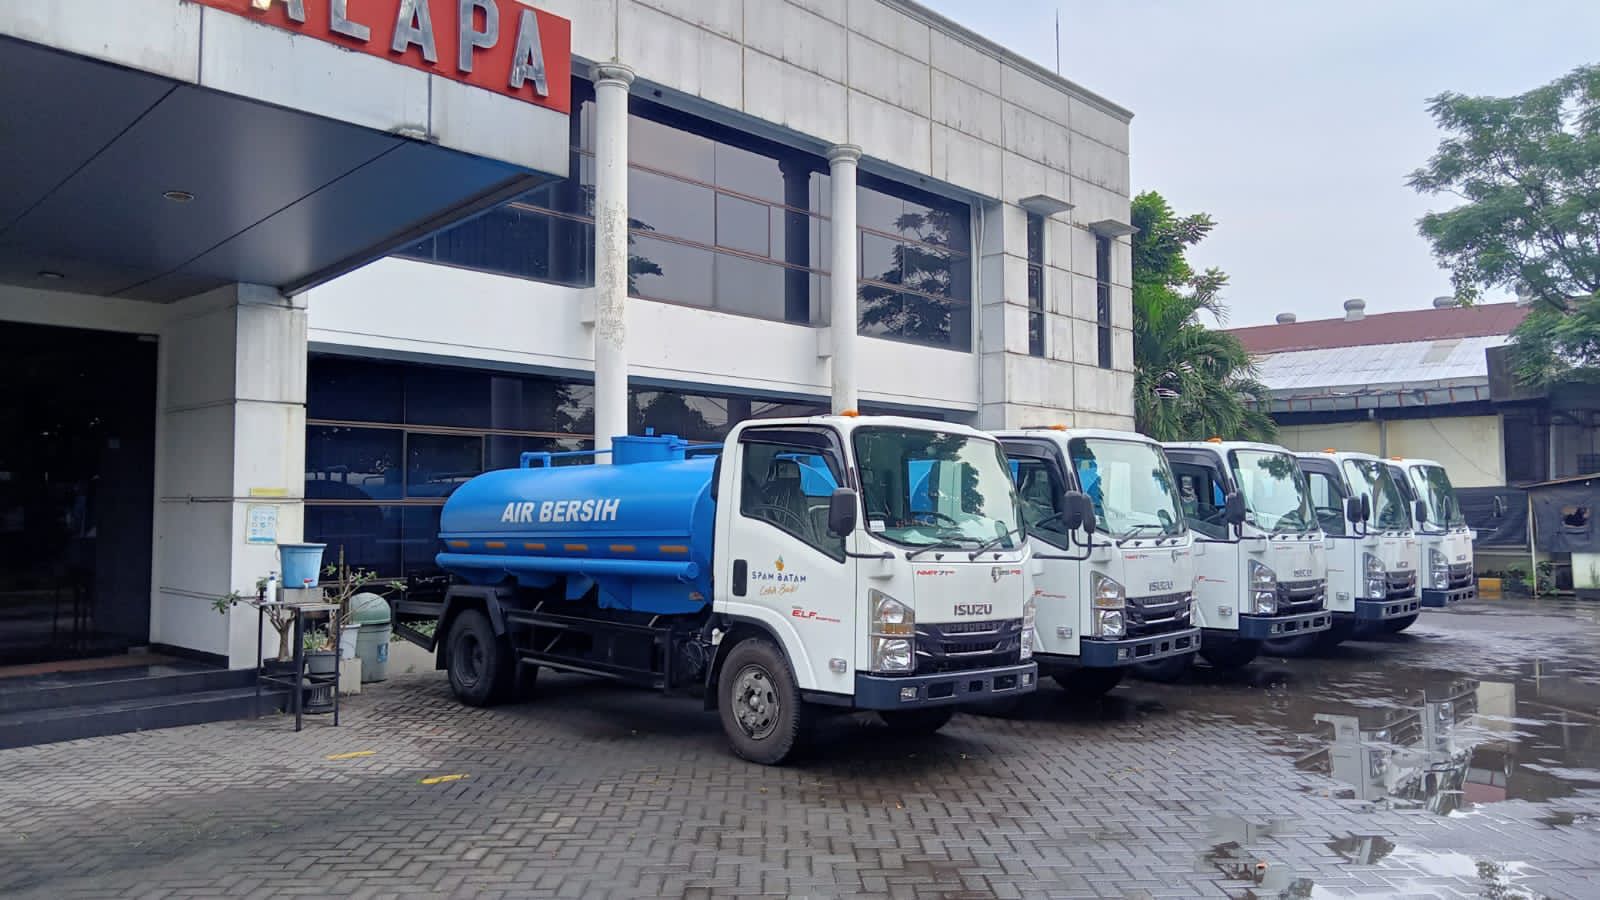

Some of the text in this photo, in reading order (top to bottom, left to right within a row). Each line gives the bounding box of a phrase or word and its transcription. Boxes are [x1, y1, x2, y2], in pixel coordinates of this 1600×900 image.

[501, 498, 620, 523] AIR BERSIH
[752, 571, 807, 583] SPAM BATAM
[792, 609, 817, 619] ELF
[954, 604, 993, 616] ISUZU
